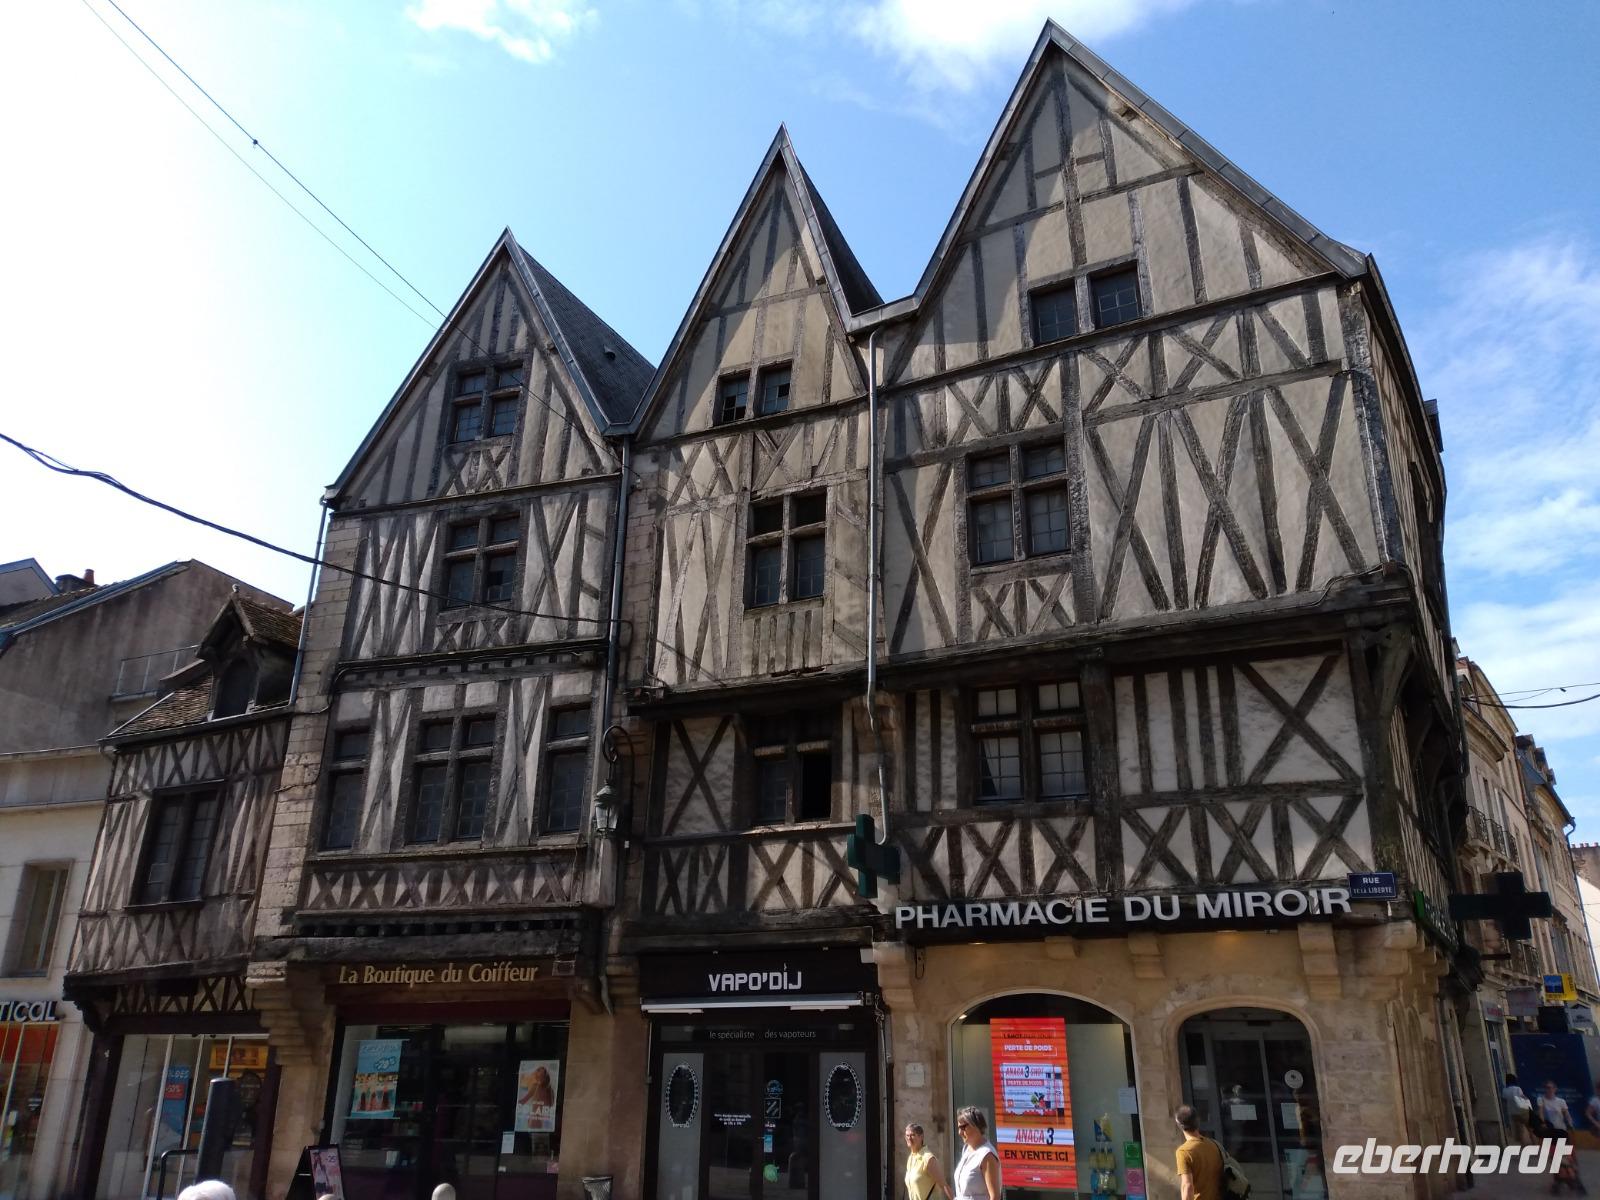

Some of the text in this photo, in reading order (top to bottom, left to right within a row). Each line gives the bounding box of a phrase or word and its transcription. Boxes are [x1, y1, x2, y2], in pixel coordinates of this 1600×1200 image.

[895, 888, 1352, 929] PHARMACIE DU MIROIR
[339, 961, 539, 988] La Boutique du Coiffeur
[709, 1031, 717, 1039] le
[765, 1030, 778, 1038] des
[779, 1030, 816, 1039] vapoteurs
[1004, 1150, 1069, 1162] EN VENTE ICI
